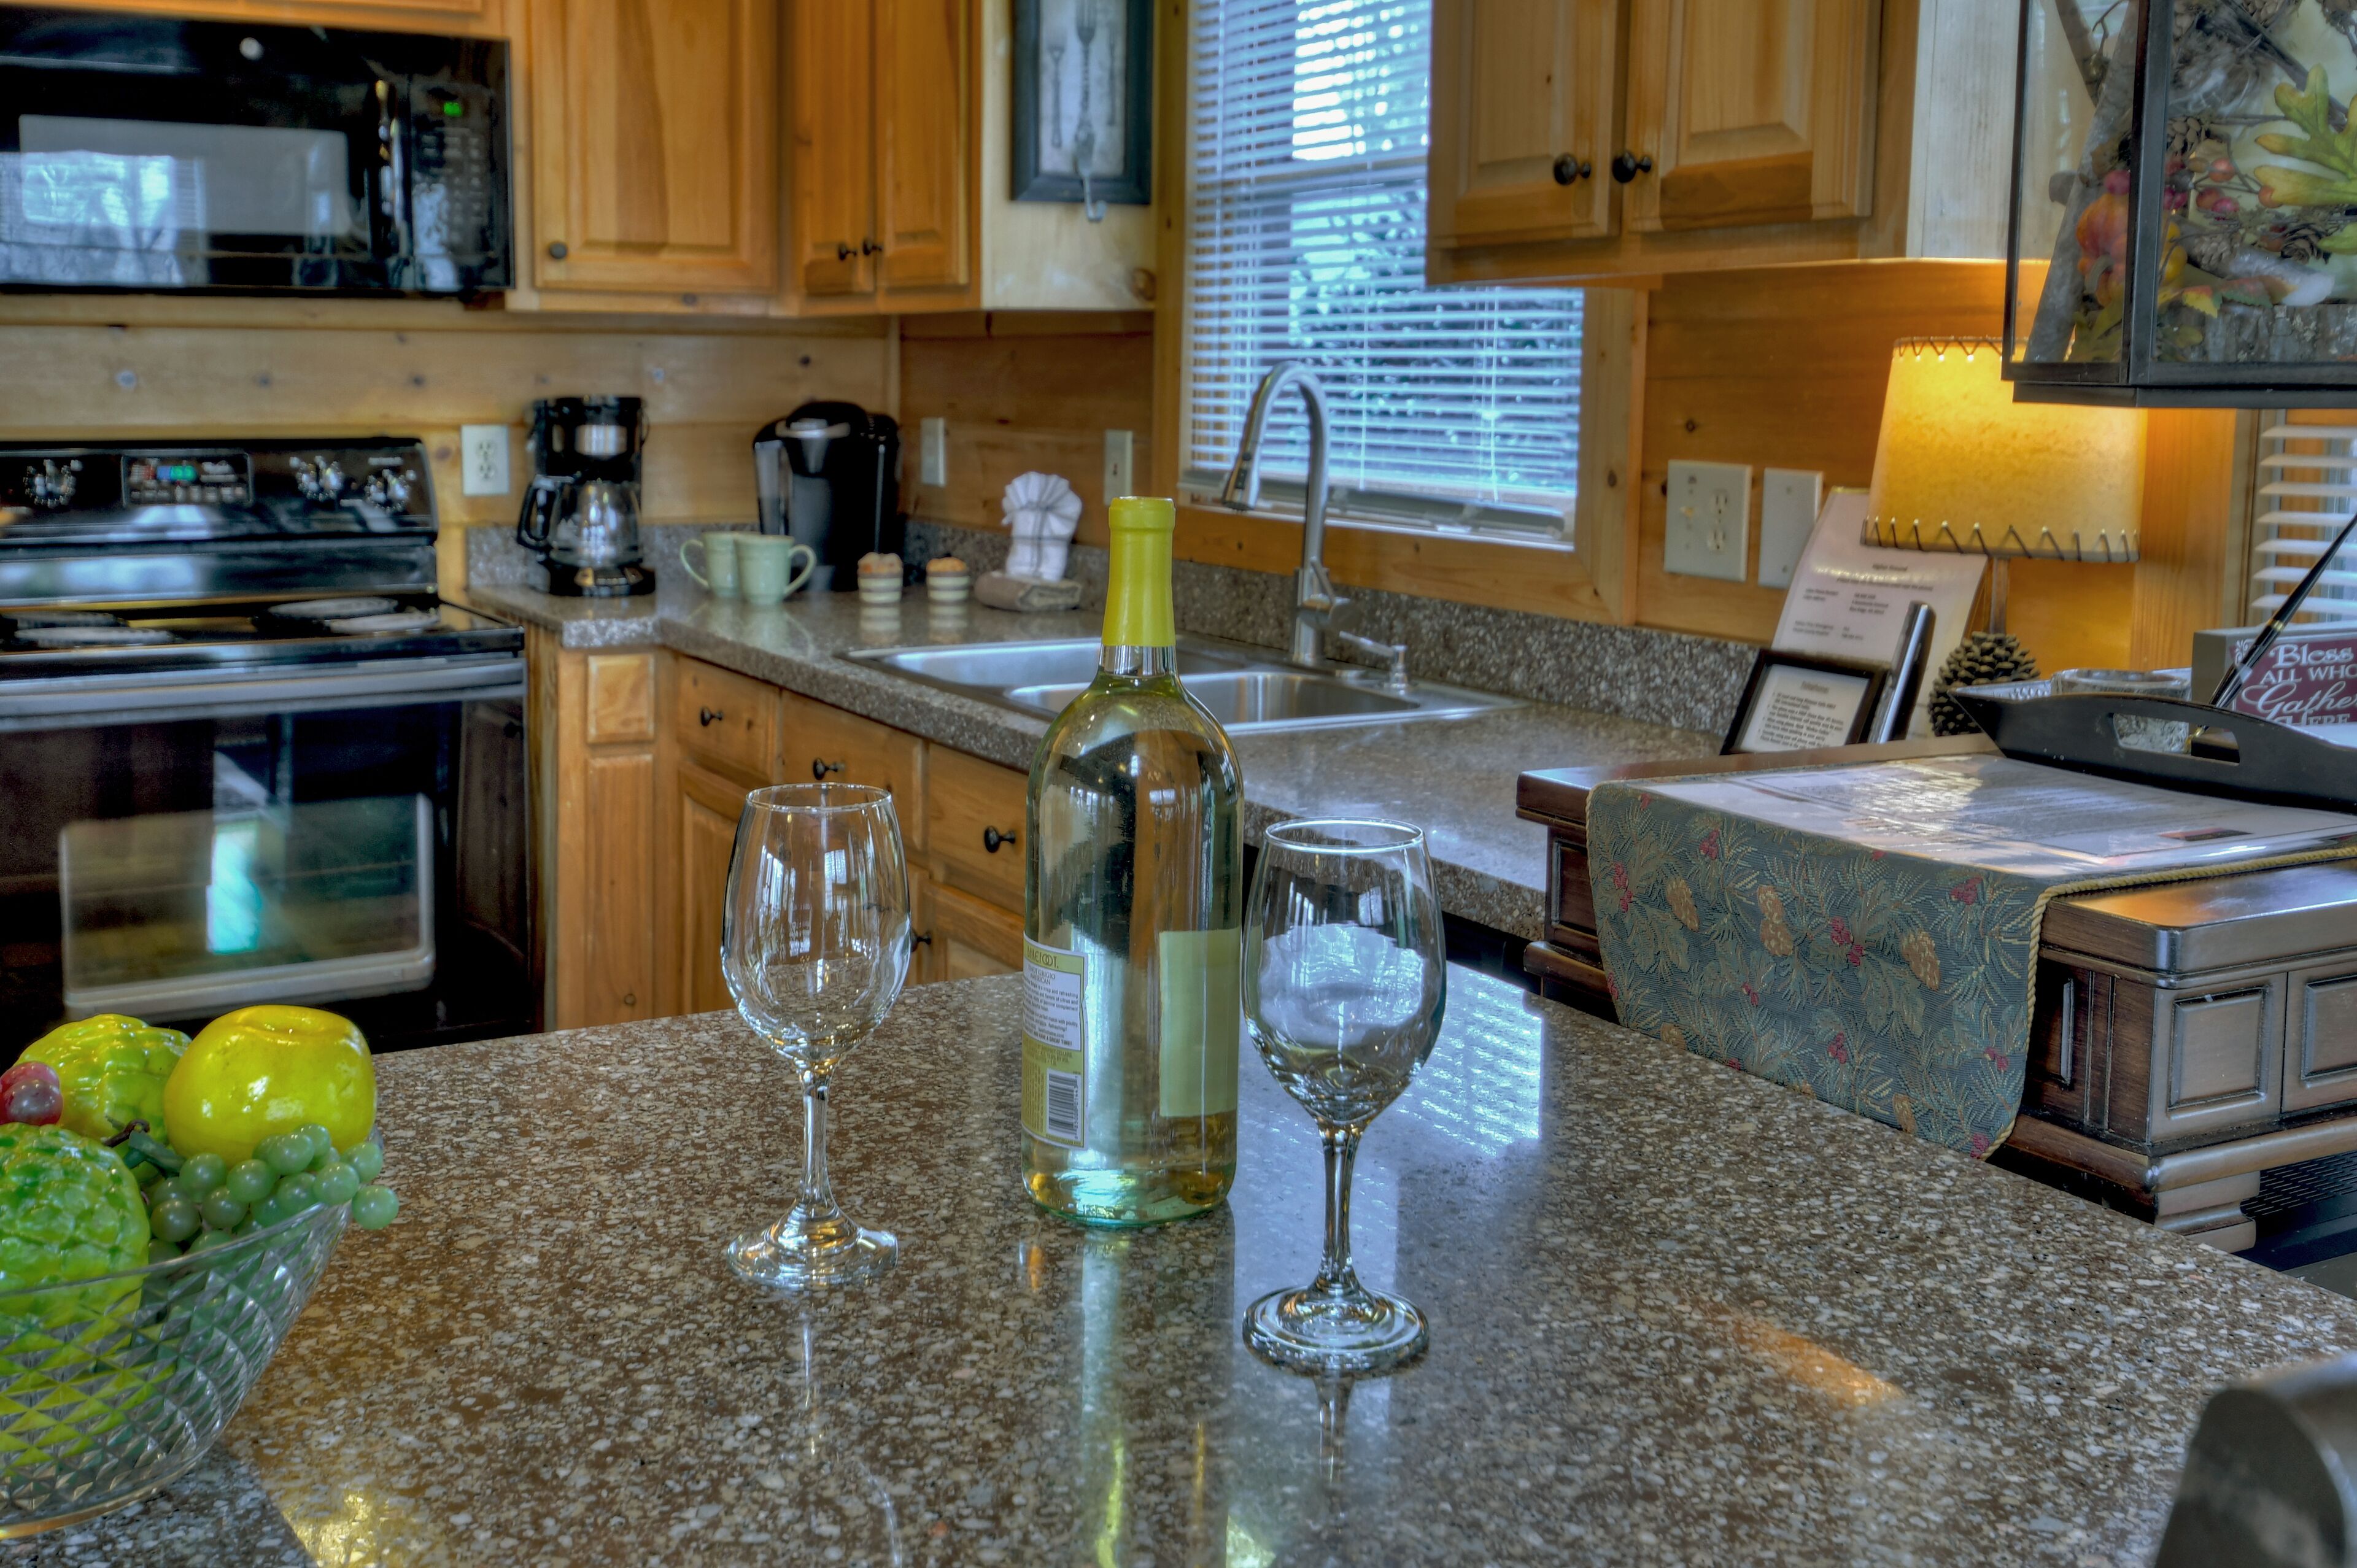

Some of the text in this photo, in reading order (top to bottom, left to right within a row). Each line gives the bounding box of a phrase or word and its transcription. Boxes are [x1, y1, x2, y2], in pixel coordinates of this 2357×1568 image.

[2269, 643, 2354, 668] Bless
[2259, 663, 2357, 685] ALL WHO
[2242, 681, 2357, 721] Gathe
